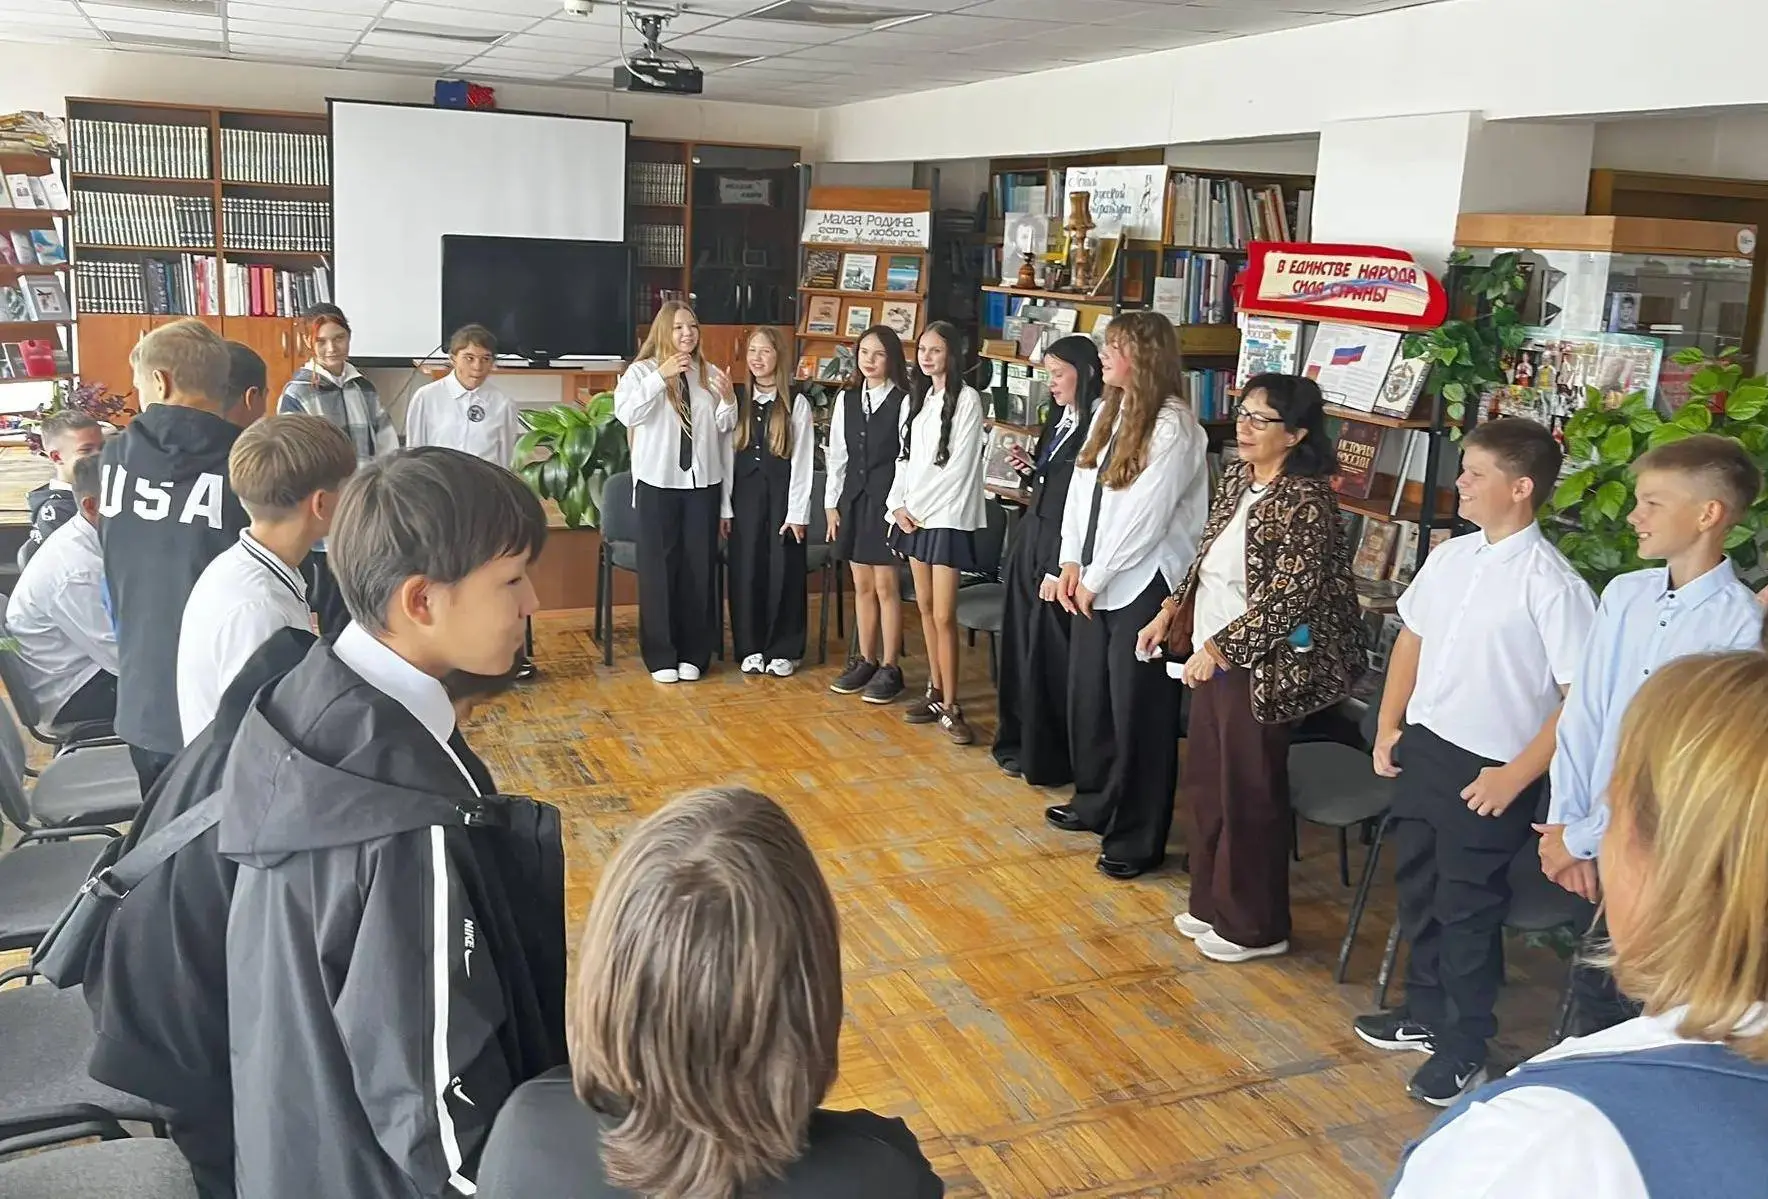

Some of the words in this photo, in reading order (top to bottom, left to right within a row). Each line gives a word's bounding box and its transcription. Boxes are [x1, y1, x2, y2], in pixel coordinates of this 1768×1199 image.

[818, 227, 848, 236] есть
[854, 228, 863, 239] у
[1276, 259, 1289, 274] В
[1289, 260, 1352, 277] ЕДИНСТВЕ
[1358, 263, 1418, 284] НАРОДА
[1330, 282, 1388, 303] СТРАНЫ
[1337, 438, 1376, 458] ИСТОРИЯ
[98, 463, 225, 530] USA
[463, 917, 476, 950] NIKE
